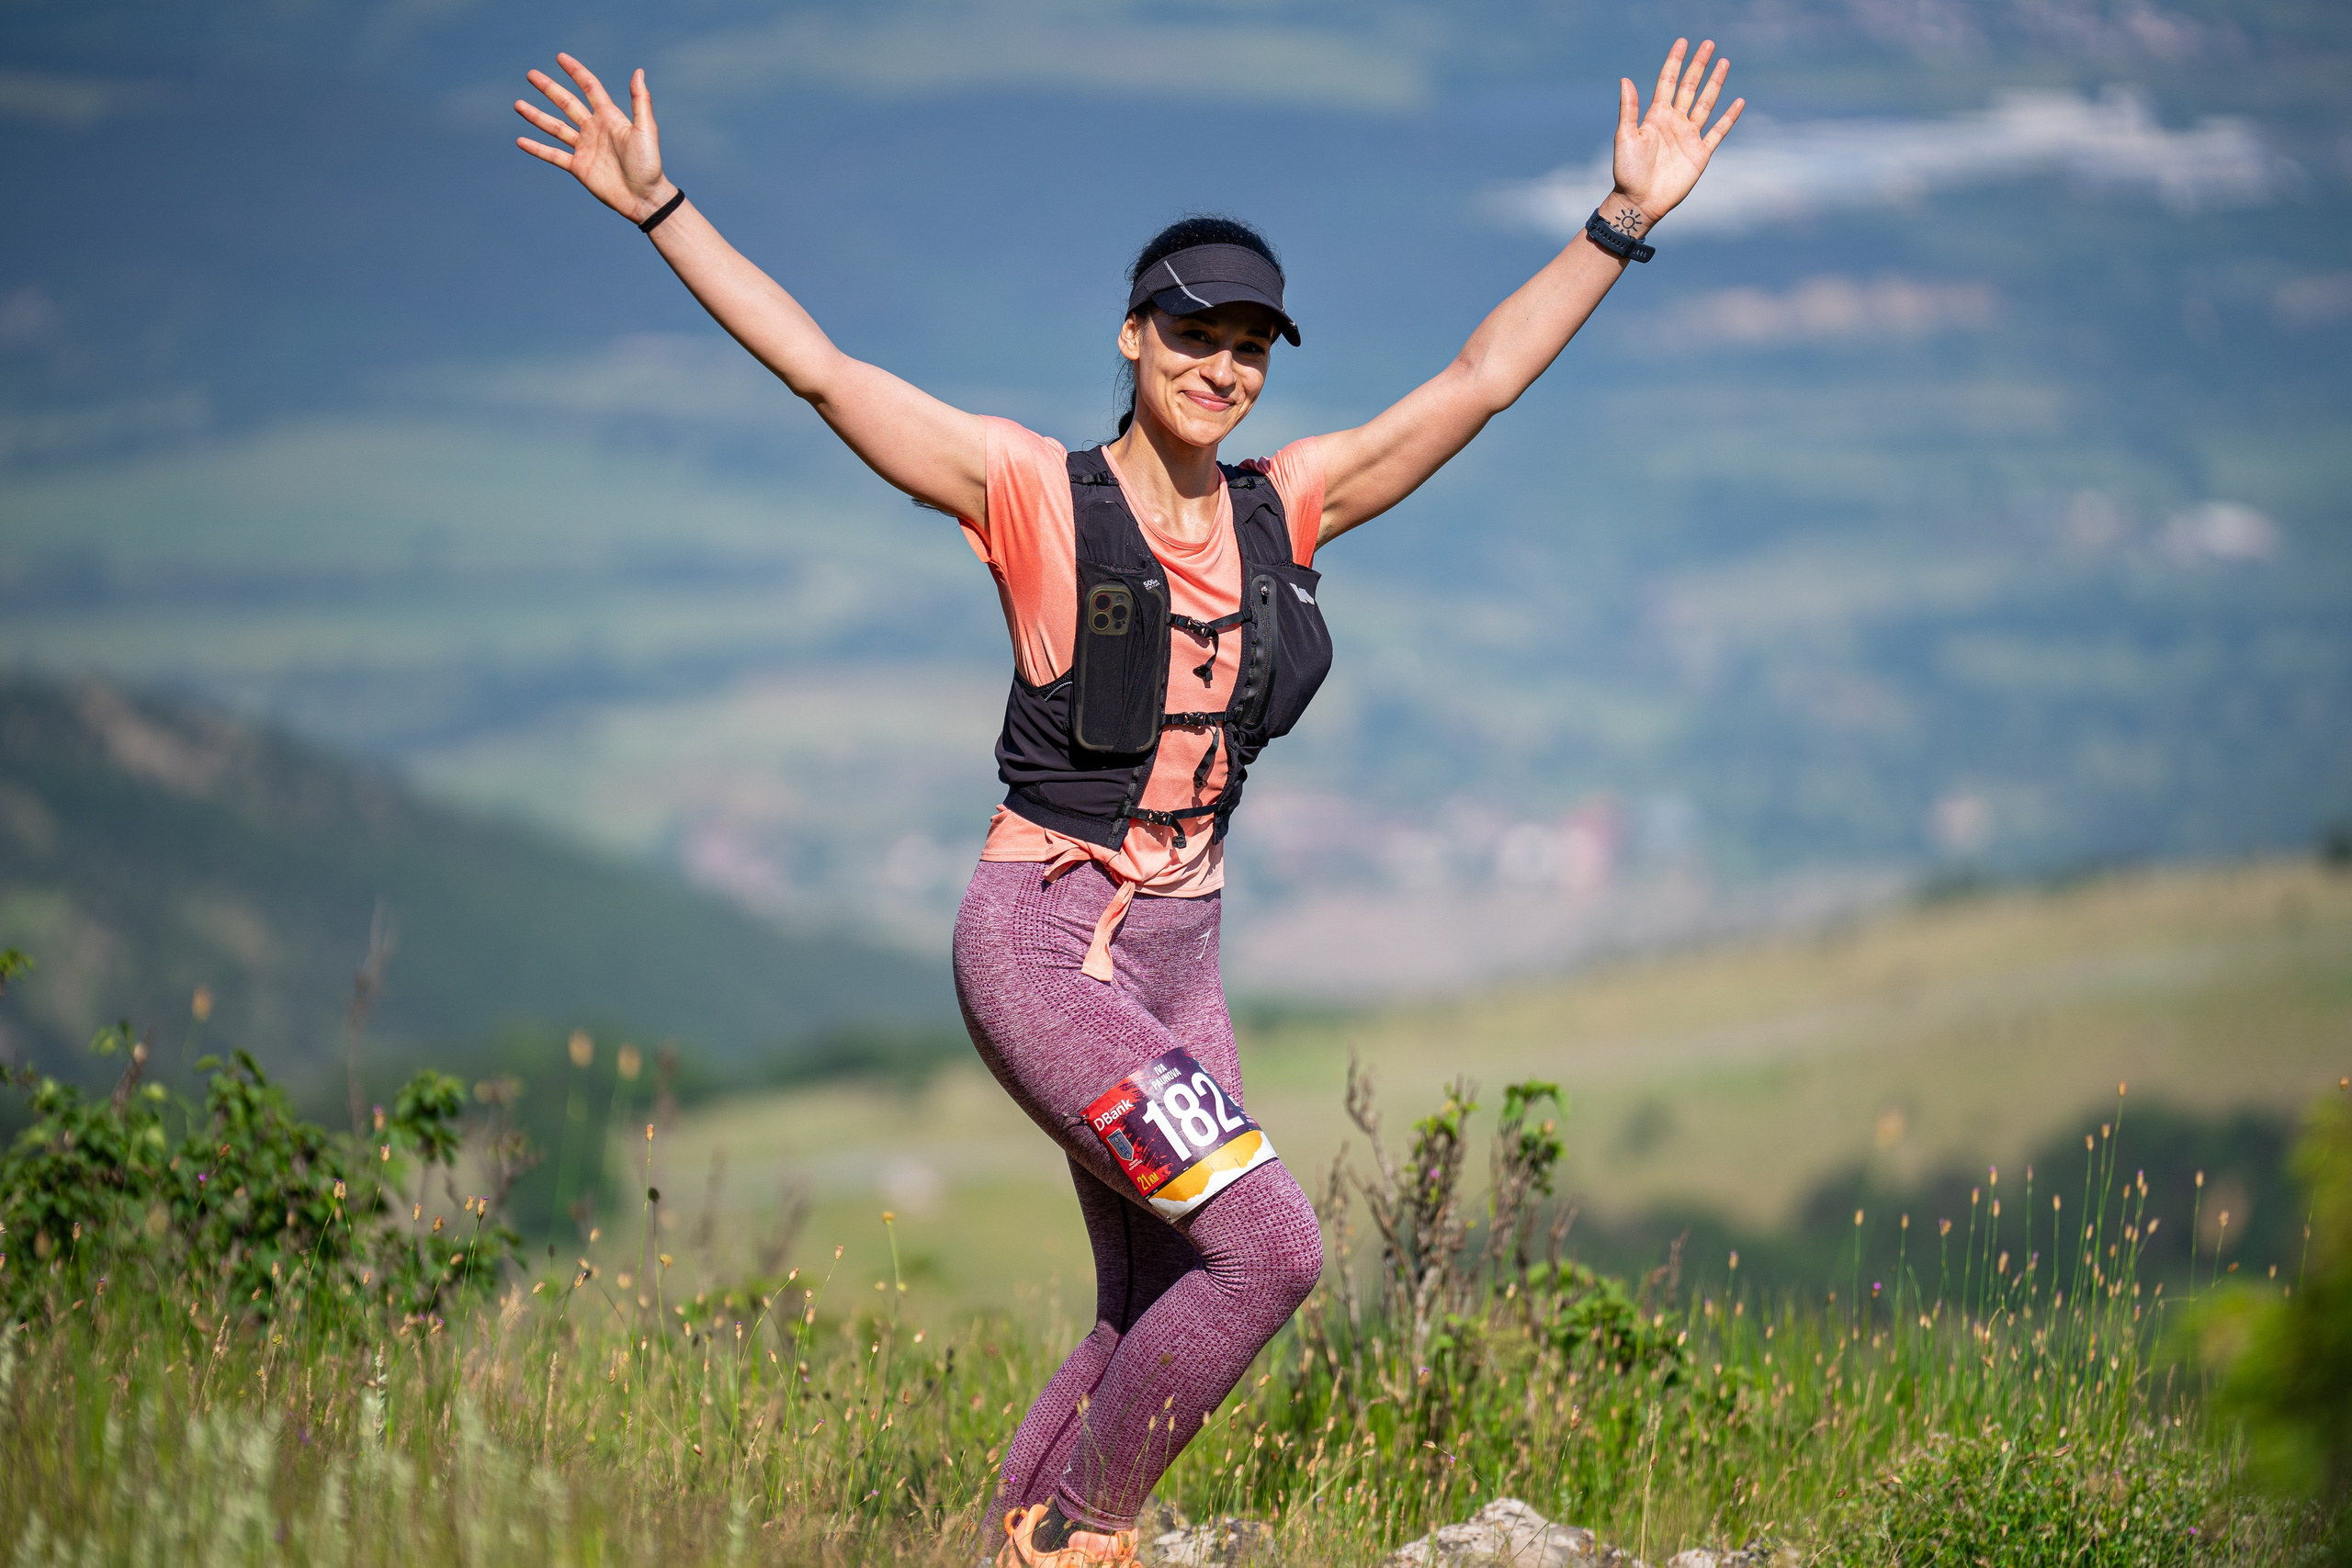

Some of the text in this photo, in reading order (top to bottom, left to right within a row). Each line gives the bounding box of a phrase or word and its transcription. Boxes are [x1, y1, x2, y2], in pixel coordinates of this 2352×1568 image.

[1150, 1067, 1182, 1090] PAUNOVA
[1153, 1063, 1167, 1077] IVA
[1093, 1098, 1135, 1133] DBank
[1142, 1071, 1245, 1162] 182
[1136, 1173, 1160, 1191] 21 KM
